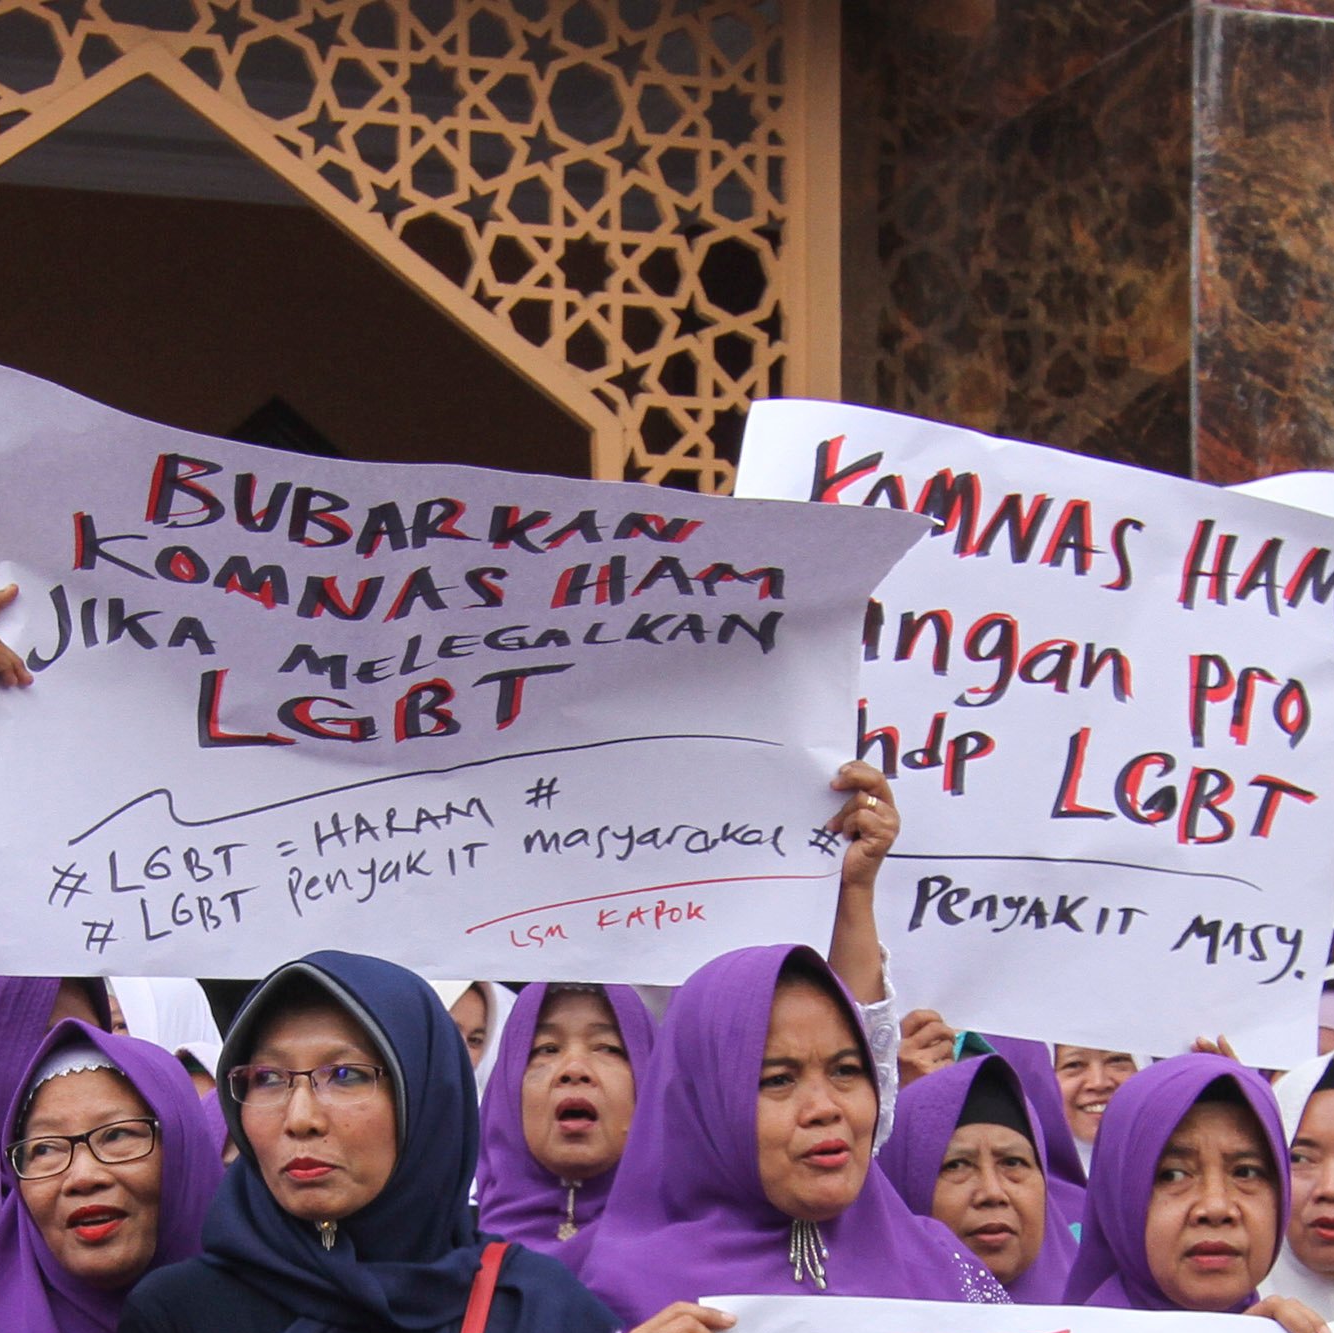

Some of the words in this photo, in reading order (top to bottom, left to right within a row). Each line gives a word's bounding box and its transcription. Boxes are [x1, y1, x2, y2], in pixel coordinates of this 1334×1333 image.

[144, 452, 703, 559] BUBARKAN
[73, 511, 508, 624] KOMNAS
[551, 556, 786, 609] HAM
[26, 583, 223, 671] JIKA
[277, 609, 785, 689] MELEGALKAN
[198, 664, 575, 749] LGBT
[314, 798, 494, 856] HARAM
[1050, 727, 1319, 845] LGBT
[597, 900, 707, 931] KAPOK
